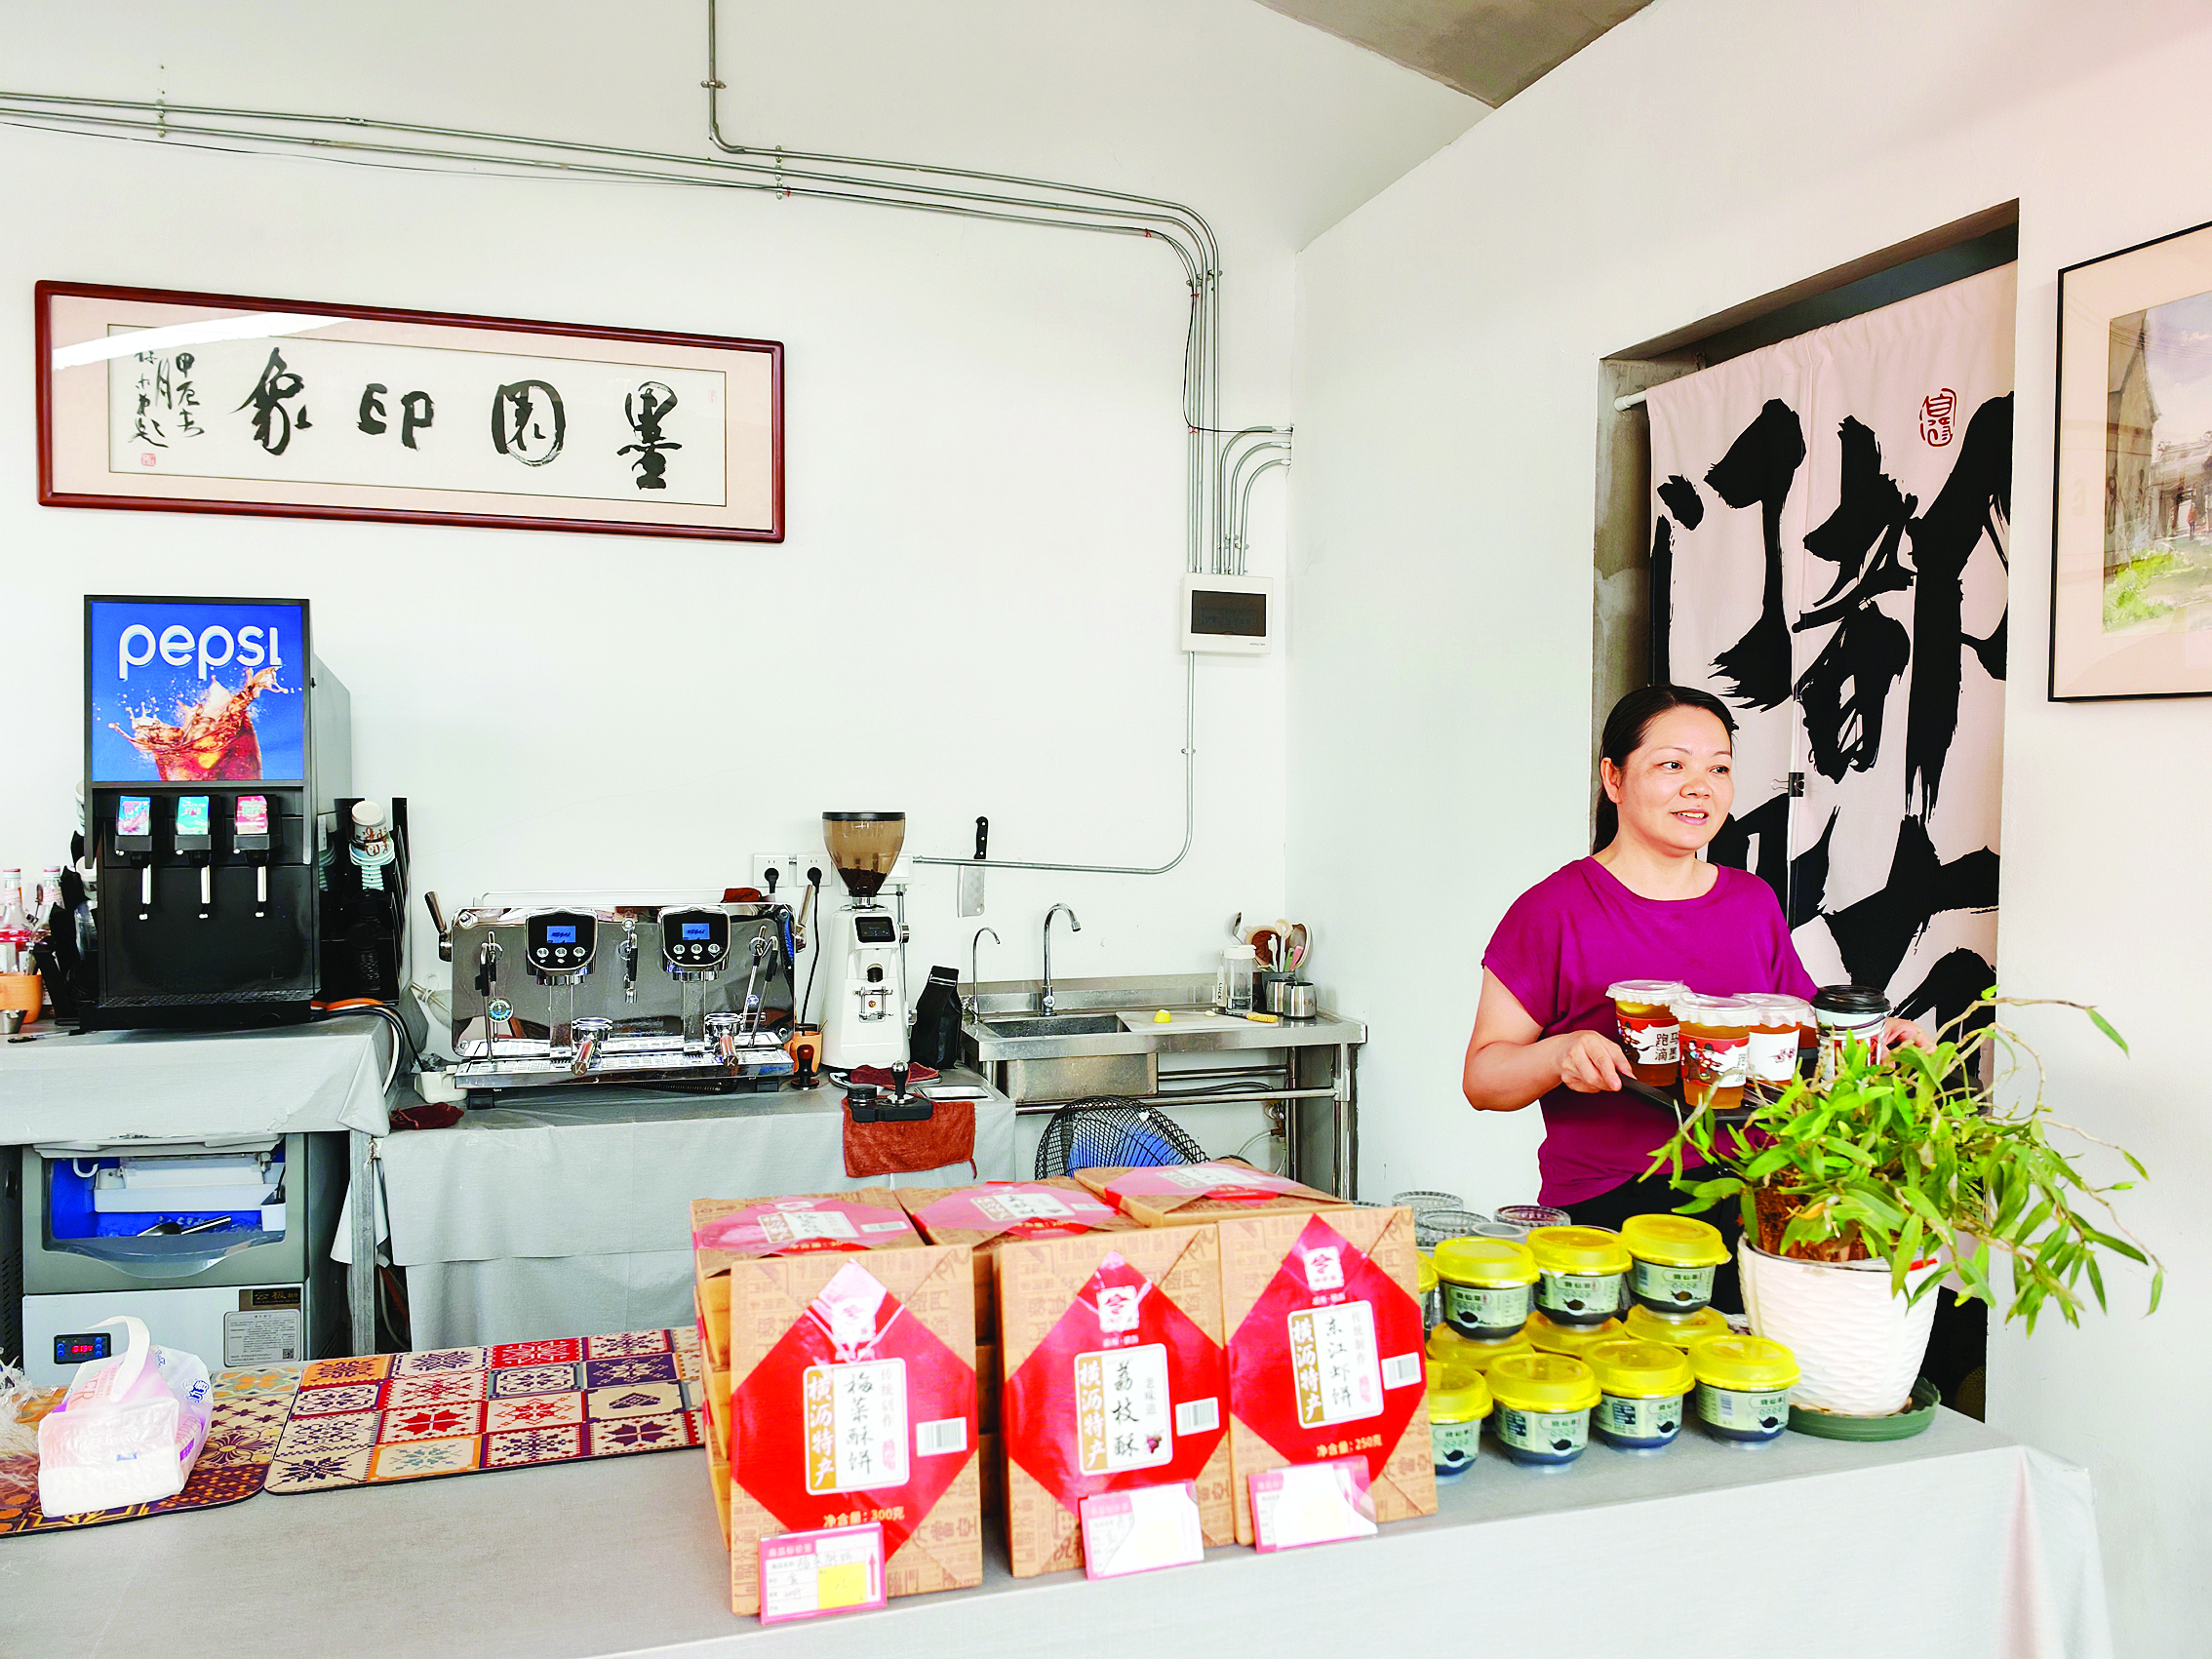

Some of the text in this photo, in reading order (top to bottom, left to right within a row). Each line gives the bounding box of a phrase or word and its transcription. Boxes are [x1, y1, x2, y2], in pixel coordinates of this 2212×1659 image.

[119, 624, 282, 681] pepsi
[1112, 1360, 1139, 1457] 荔枝酥
[1292, 1319, 1323, 1422] 横沥特产
[1324, 1317, 1353, 1407] 东江虾饼
[808, 1375, 835, 1488] 横沥特产
[844, 1370, 875, 1475] 梅菜酥饼
[1079, 1359, 1106, 1469] 横沥特产
